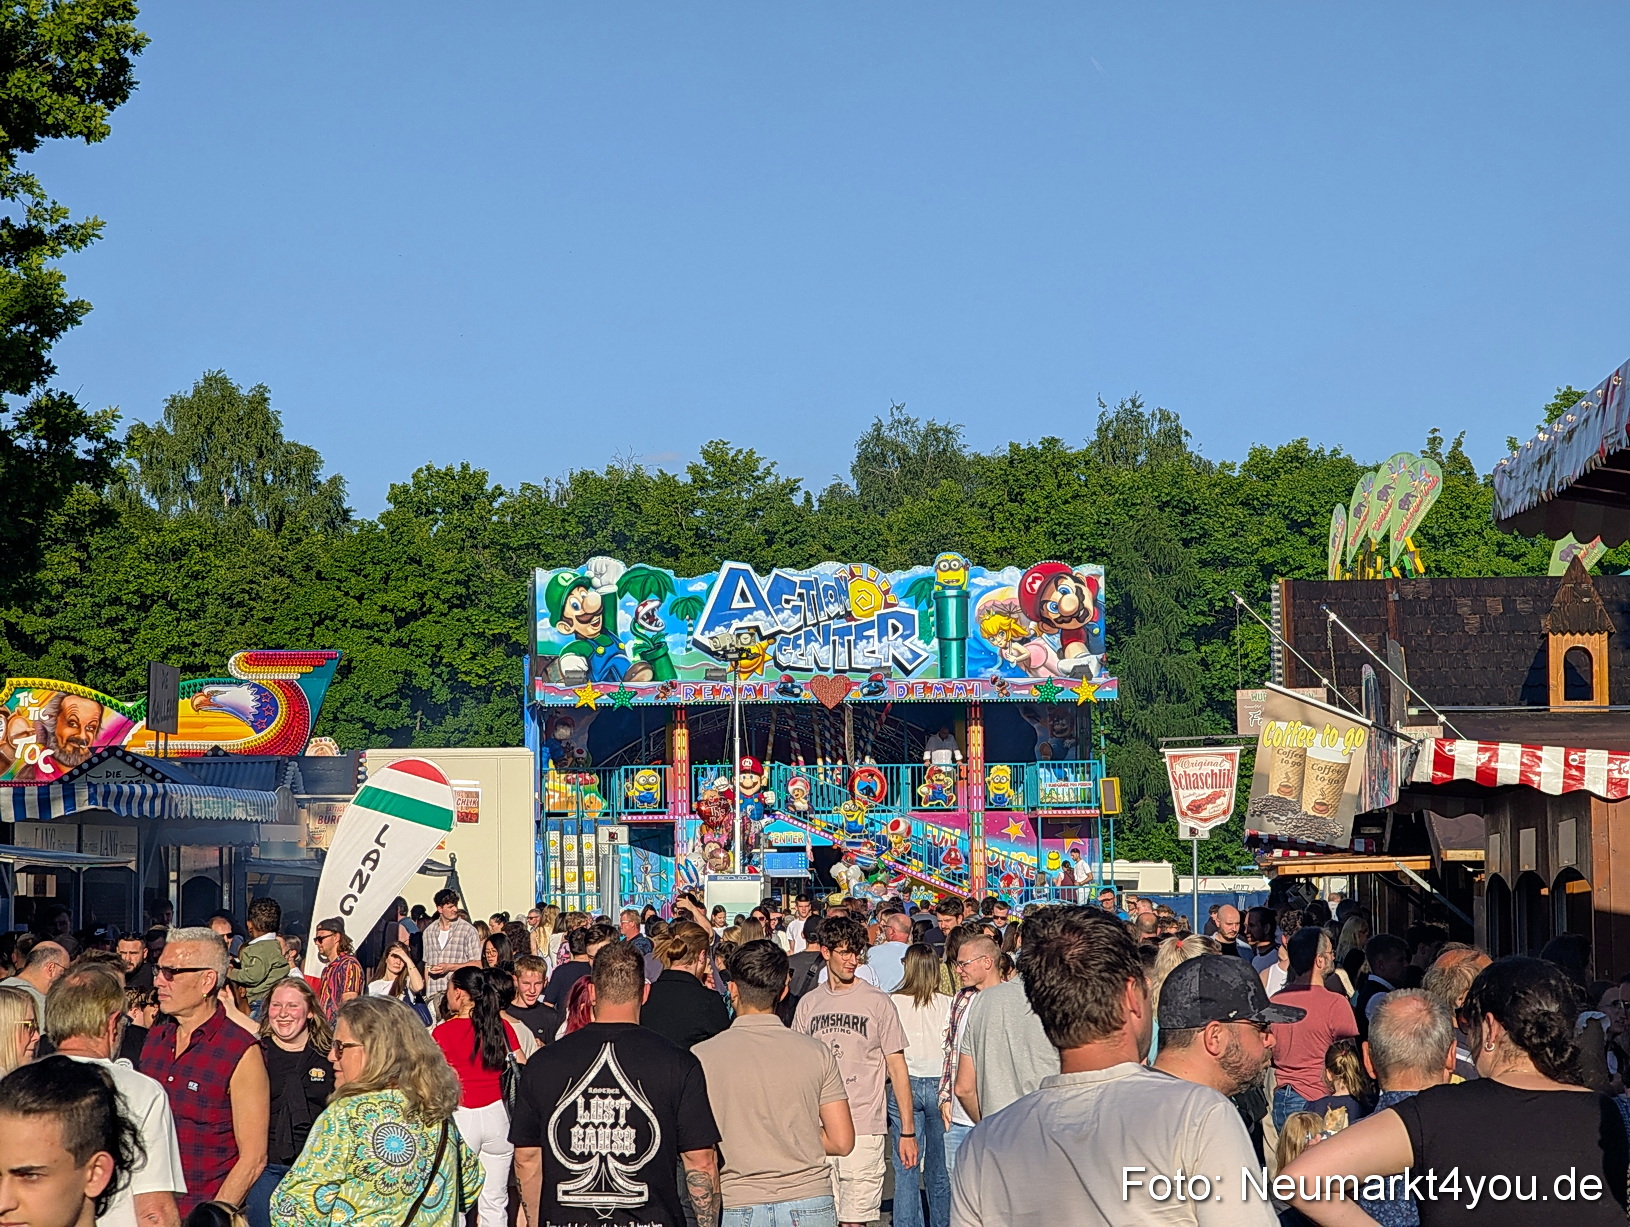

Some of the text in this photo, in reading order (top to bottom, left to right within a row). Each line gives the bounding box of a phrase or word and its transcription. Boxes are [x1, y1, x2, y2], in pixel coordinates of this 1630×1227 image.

[693, 560, 852, 645] ACTION
[775, 607, 930, 676] CENTER
[682, 684, 770, 701] REMMI
[894, 682, 982, 699] DEMMI
[1263, 720, 1365, 756] Coffee to go
[12, 734, 55, 774] TOC
[1276, 747, 1304, 762] Coffee
[1280, 758, 1302, 768] to go
[105, 770, 122, 778] DIE
[1180, 758, 1227, 771] Original
[1311, 762, 1343, 776] Coffee
[1171, 768, 1234, 791] Schaschlik
[1315, 774, 1340, 786] to go
[456, 798, 479, 807] CHLIK
[338, 823, 390, 917] LANG
[985, 847, 1037, 880] OUSE
[810, 1013, 869, 1040] GYMSHARK
[821, 1027, 852, 1035] LIFTING
[576, 1095, 632, 1127] LOST
[570, 1124, 637, 1158] CAUSE
